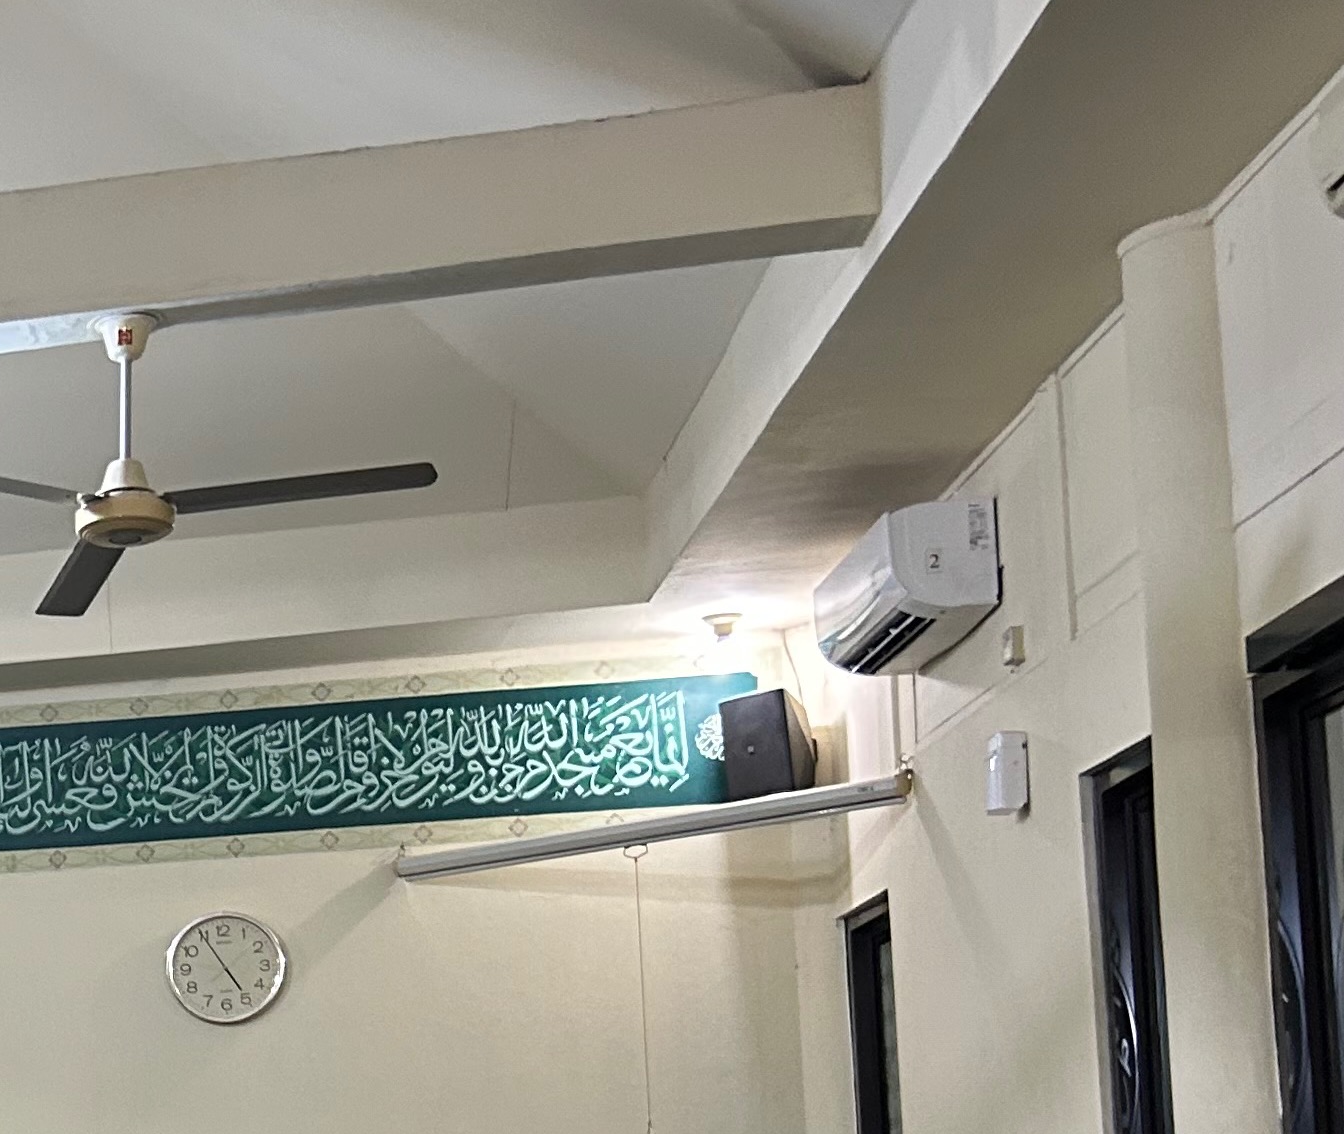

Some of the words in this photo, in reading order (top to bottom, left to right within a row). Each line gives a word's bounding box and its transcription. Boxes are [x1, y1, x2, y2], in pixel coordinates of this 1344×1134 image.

[929, 553, 940, 569] 2
[216, 924, 230, 937] 12
[183, 945, 199, 958] 10
[253, 940, 264, 954] 2
[180, 963, 192, 976] 9
[259, 959, 271, 972] 3
[186, 981, 198, 994] 8
[254, 977, 265, 990] 4
[204, 994, 214, 1007] 7
[221, 998, 233, 1011] 6
[240, 992, 252, 1006] 5
